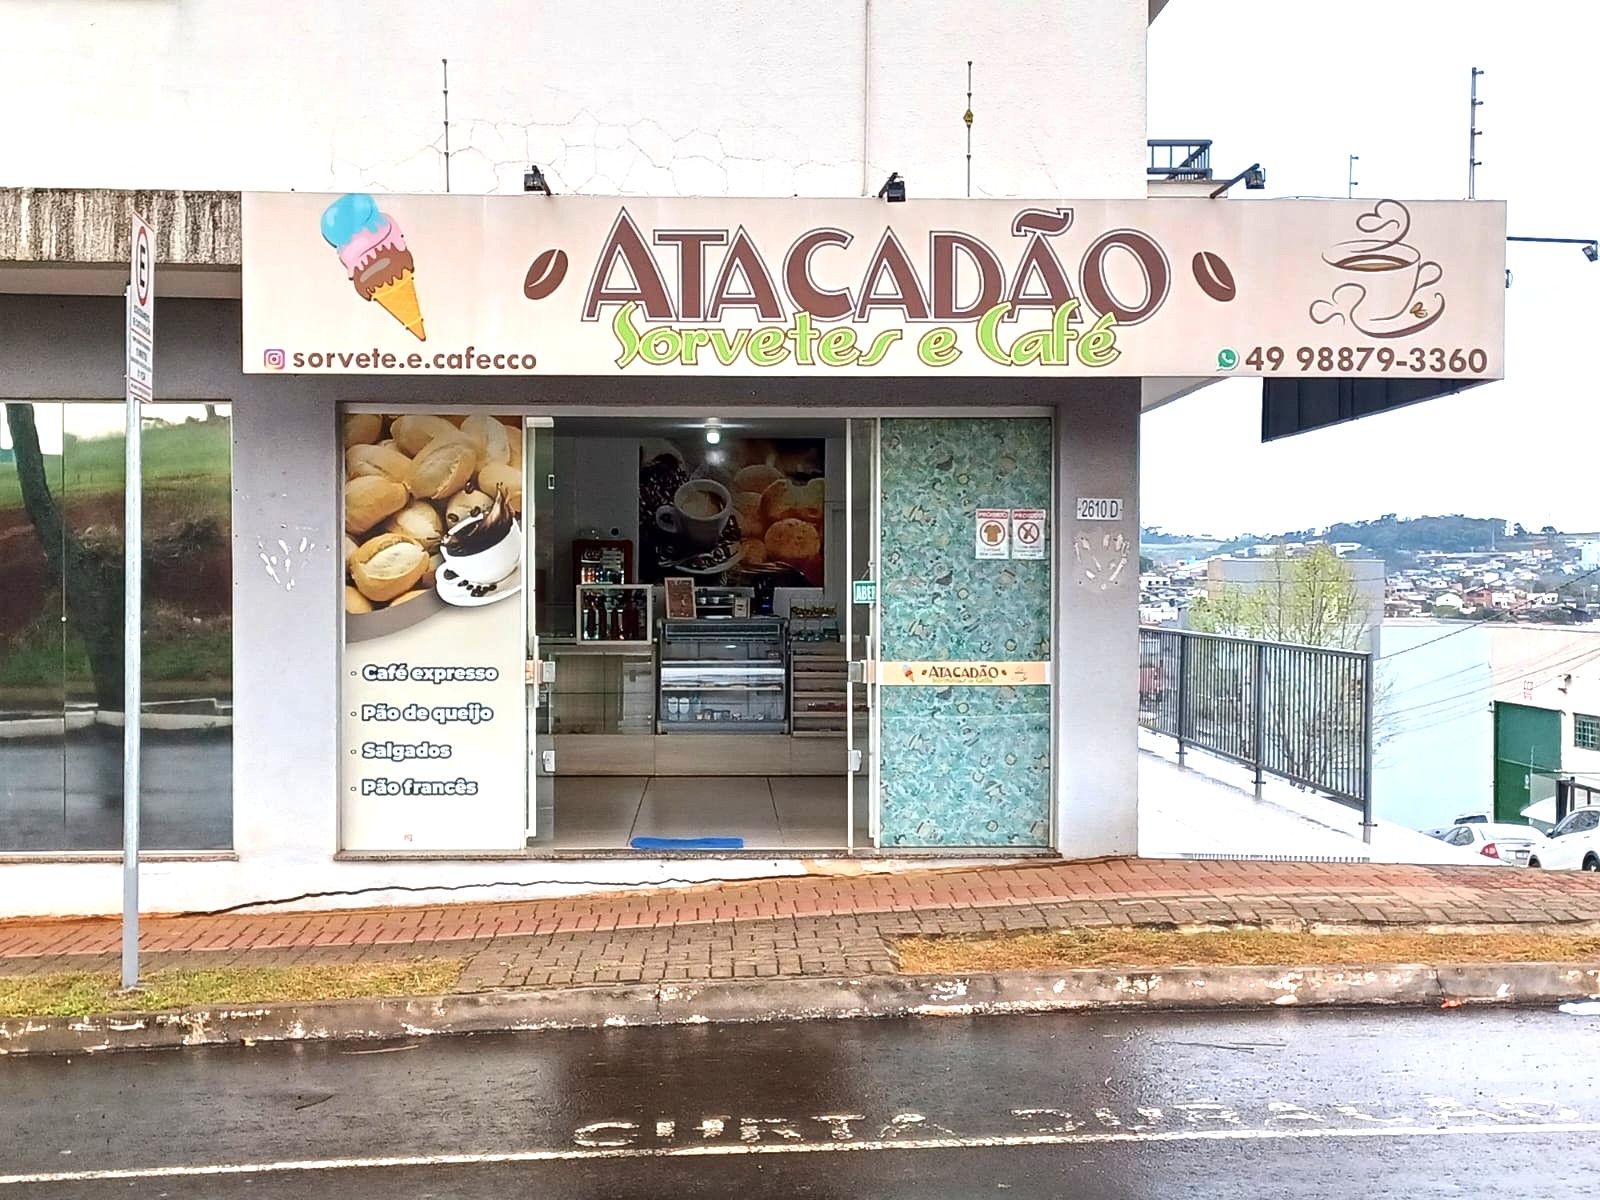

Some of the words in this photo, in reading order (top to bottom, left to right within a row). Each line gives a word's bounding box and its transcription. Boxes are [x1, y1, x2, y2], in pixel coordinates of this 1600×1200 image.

[139, 244, 146, 288] E
[581, 207, 1171, 324] ATACADÃO
[612, 301, 903, 370] Sorvetes
[918, 326, 962, 367] e
[976, 298, 1121, 367] Café
[293, 347, 537, 371] sorvete.e.cafecco
[1245, 346, 1285, 373] 49
[1296, 346, 1488, 374] 98879-3360
[1081, 499, 1107, 518] 2610
[1110, 500, 1119, 518] D
[362, 663, 409, 682] Café
[410, 667, 499, 685] expresso
[929, 664, 999, 679] ATACADÃO
[362, 703, 401, 722] Pão
[403, 704, 430, 721] de
[431, 702, 495, 725] queijo
[362, 741, 452, 762] Salgados
[362, 778, 401, 796] Pão
[402, 777, 479, 796] francês
